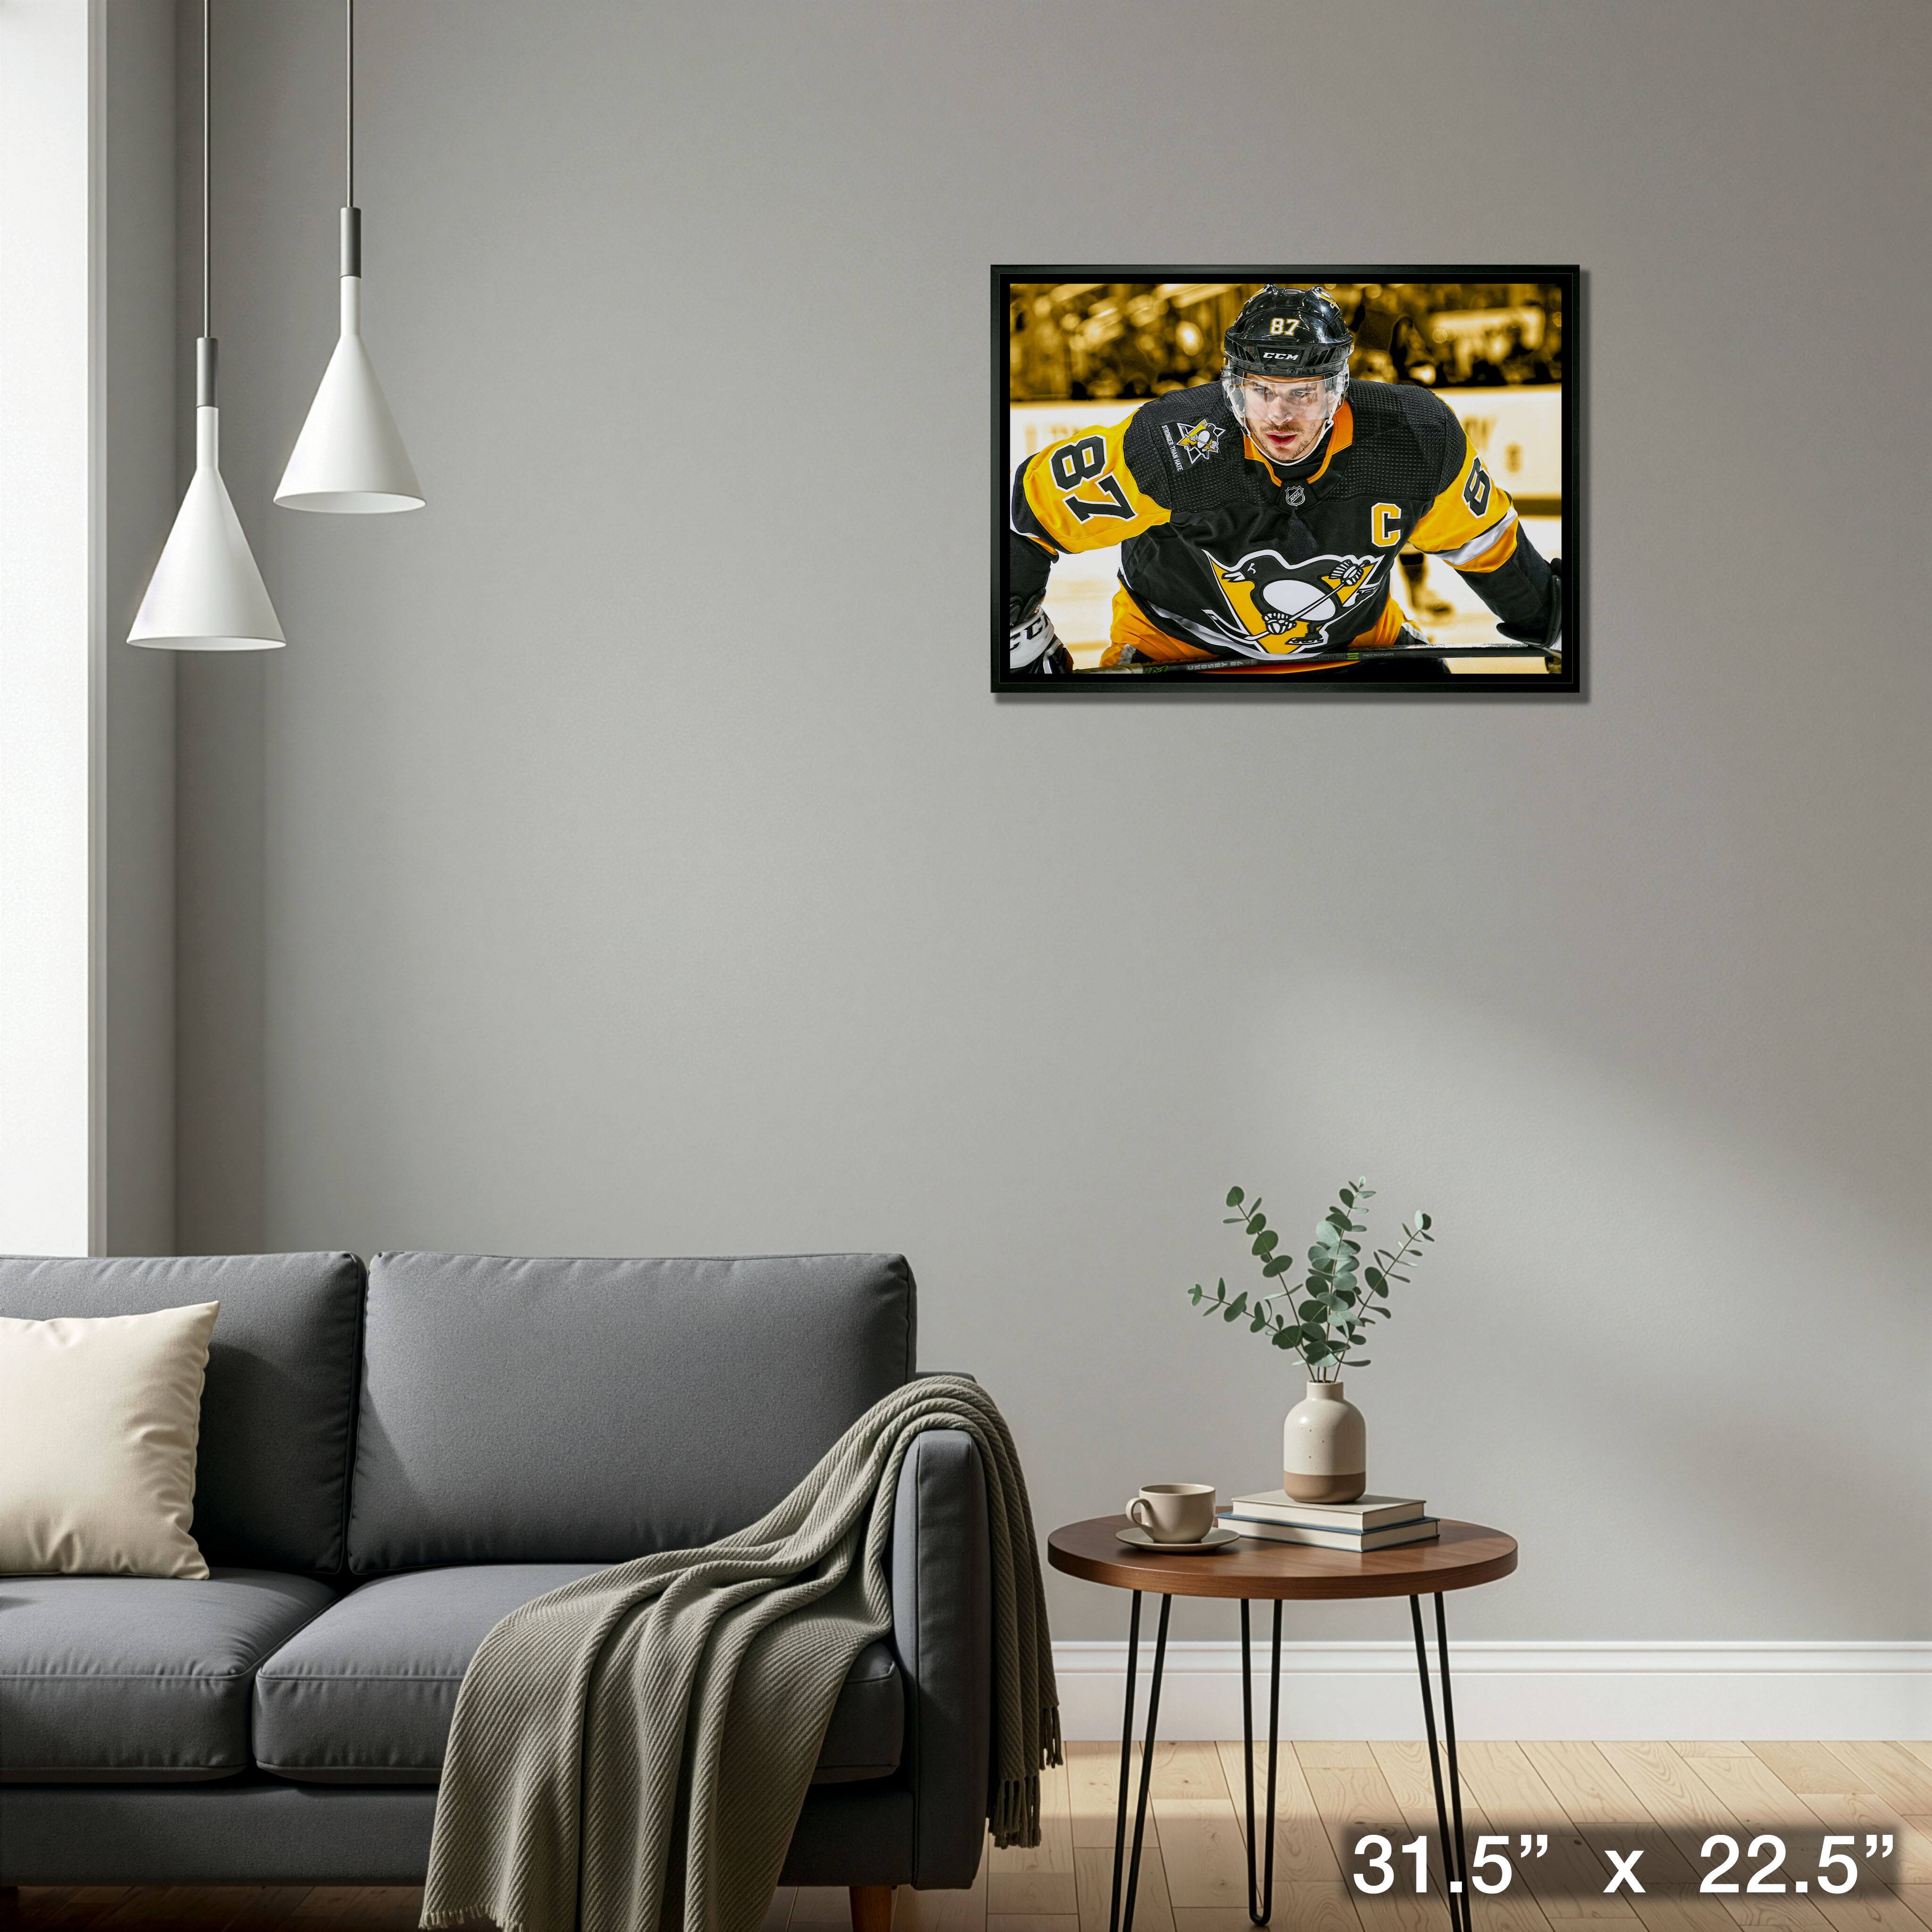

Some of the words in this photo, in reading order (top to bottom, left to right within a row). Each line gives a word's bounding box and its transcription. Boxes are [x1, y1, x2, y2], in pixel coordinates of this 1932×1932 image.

[1269, 317, 1300, 336] 87
[1263, 352, 1299, 360] CCM
[1161, 425, 1174, 446] STRONGER
[1170, 445, 1179, 459] THAN
[1174, 458, 1183, 472] HATE
[1049, 434, 1139, 524] 87
[1290, 491, 1300, 502] NHL
[1371, 502, 1402, 547] C
[1187, 662, 1228, 670] CROSBY
